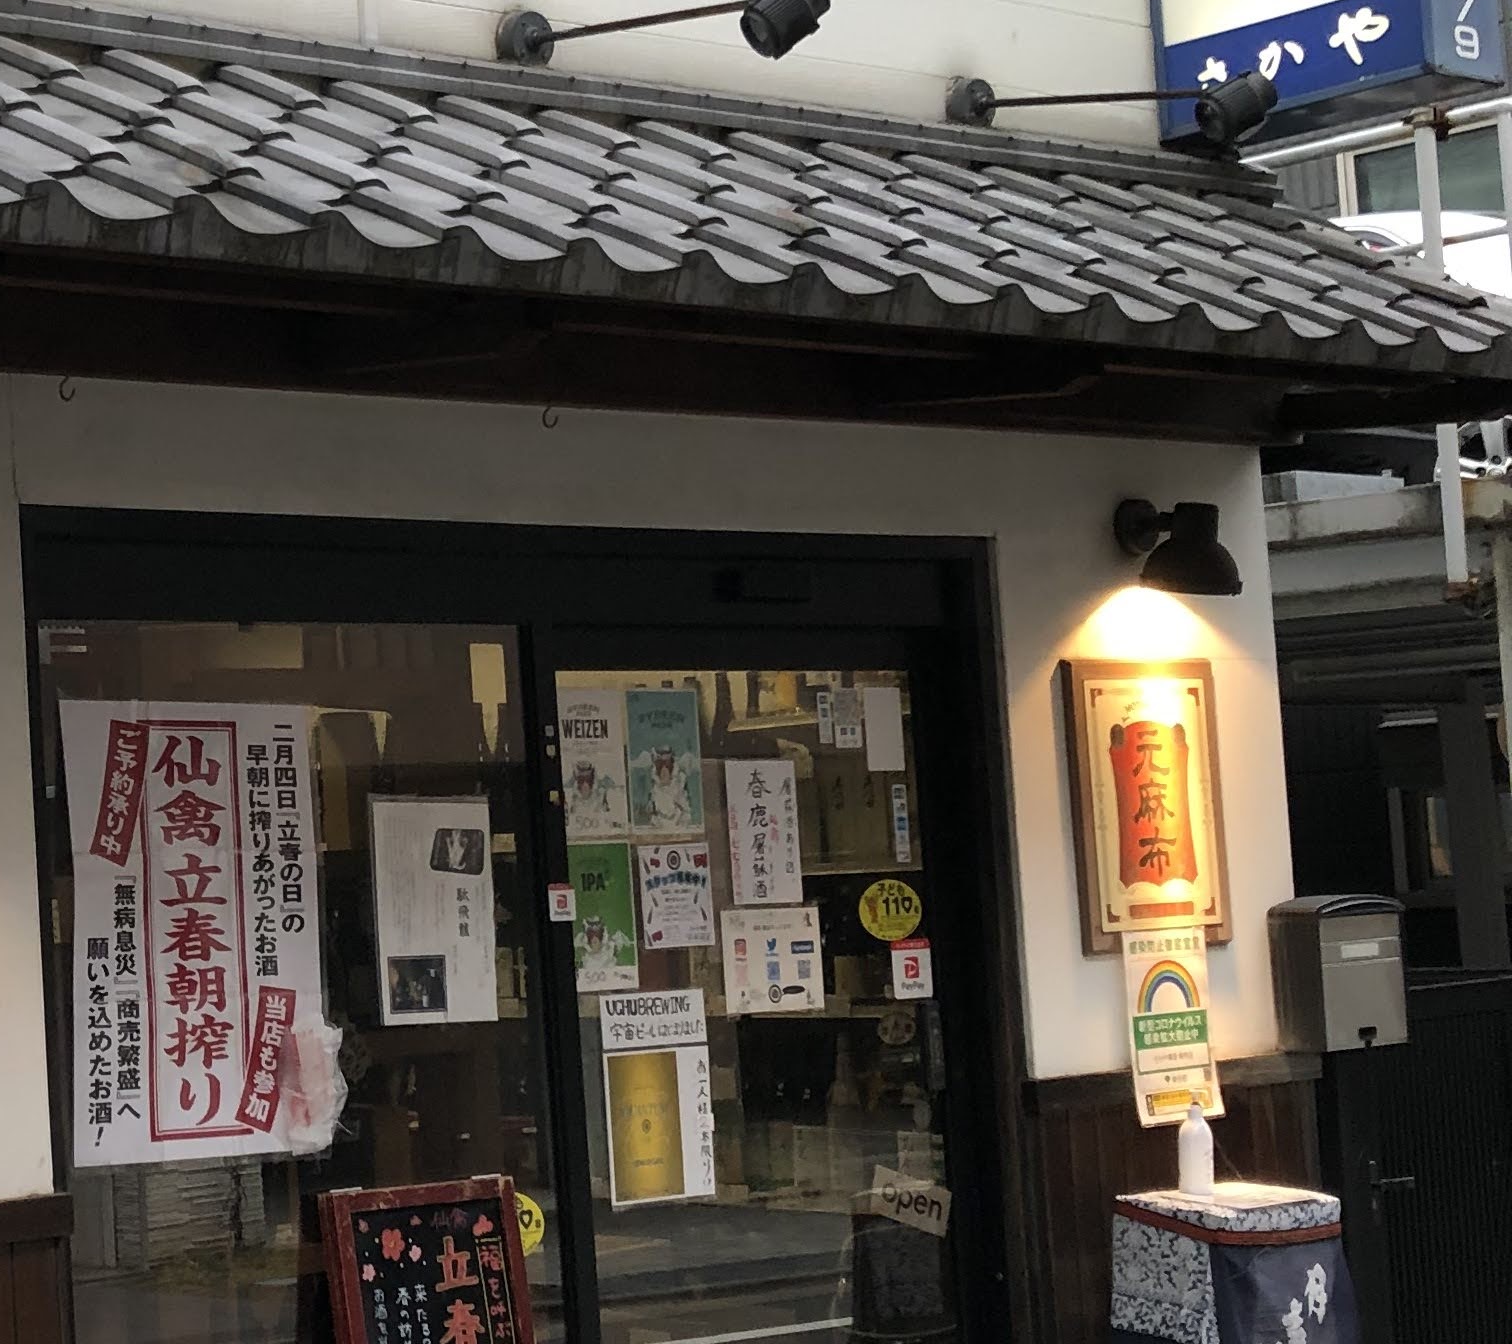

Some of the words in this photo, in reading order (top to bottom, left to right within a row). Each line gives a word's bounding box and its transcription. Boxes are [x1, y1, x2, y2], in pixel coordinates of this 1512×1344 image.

[99, 726, 142, 858] ご予約承り中
[562, 719, 608, 739] WEIZEN
[246, 743, 279, 977] 早朝に搾りあがったお酒
[1131, 728, 1177, 877] 元麻布
[152, 733, 235, 1127] 仙禽立春朝搾り
[581, 871, 606, 892] IPA
[244, 994, 287, 1126] 当店も参加
[881, 1182, 942, 1220] open
